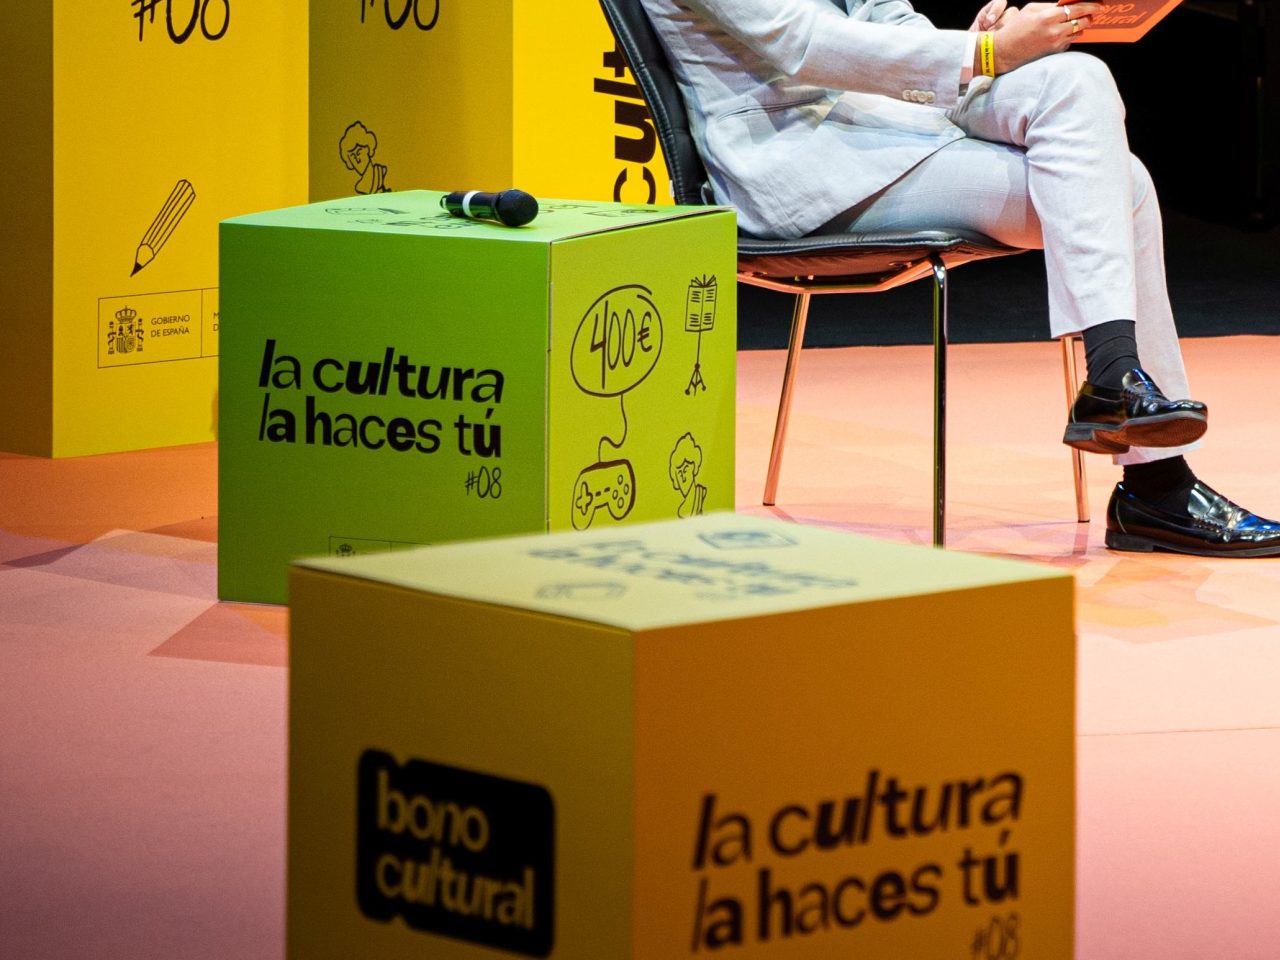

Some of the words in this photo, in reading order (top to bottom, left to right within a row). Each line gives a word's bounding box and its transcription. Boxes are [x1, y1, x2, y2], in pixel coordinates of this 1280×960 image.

[150, 314, 191, 326] GOBIERNO
[150, 328, 161, 338] DE
[162, 325, 190, 337] ESPAÑA
[590, 300, 653, 389] 400€
[258, 339, 300, 390] la
[312, 346, 505, 404] cultura
[258, 392, 297, 442] la
[305, 395, 443, 454] haces
[454, 407, 501, 458] tú
[464, 465, 502, 500] #08
[375, 768, 490, 853] bono
[692, 793, 753, 870] la
[769, 769, 1024, 857] cultura
[372, 844, 537, 932] cultural
[691, 876, 744, 953] la
[758, 863, 943, 941] haces
[958, 829, 1020, 906] tú
